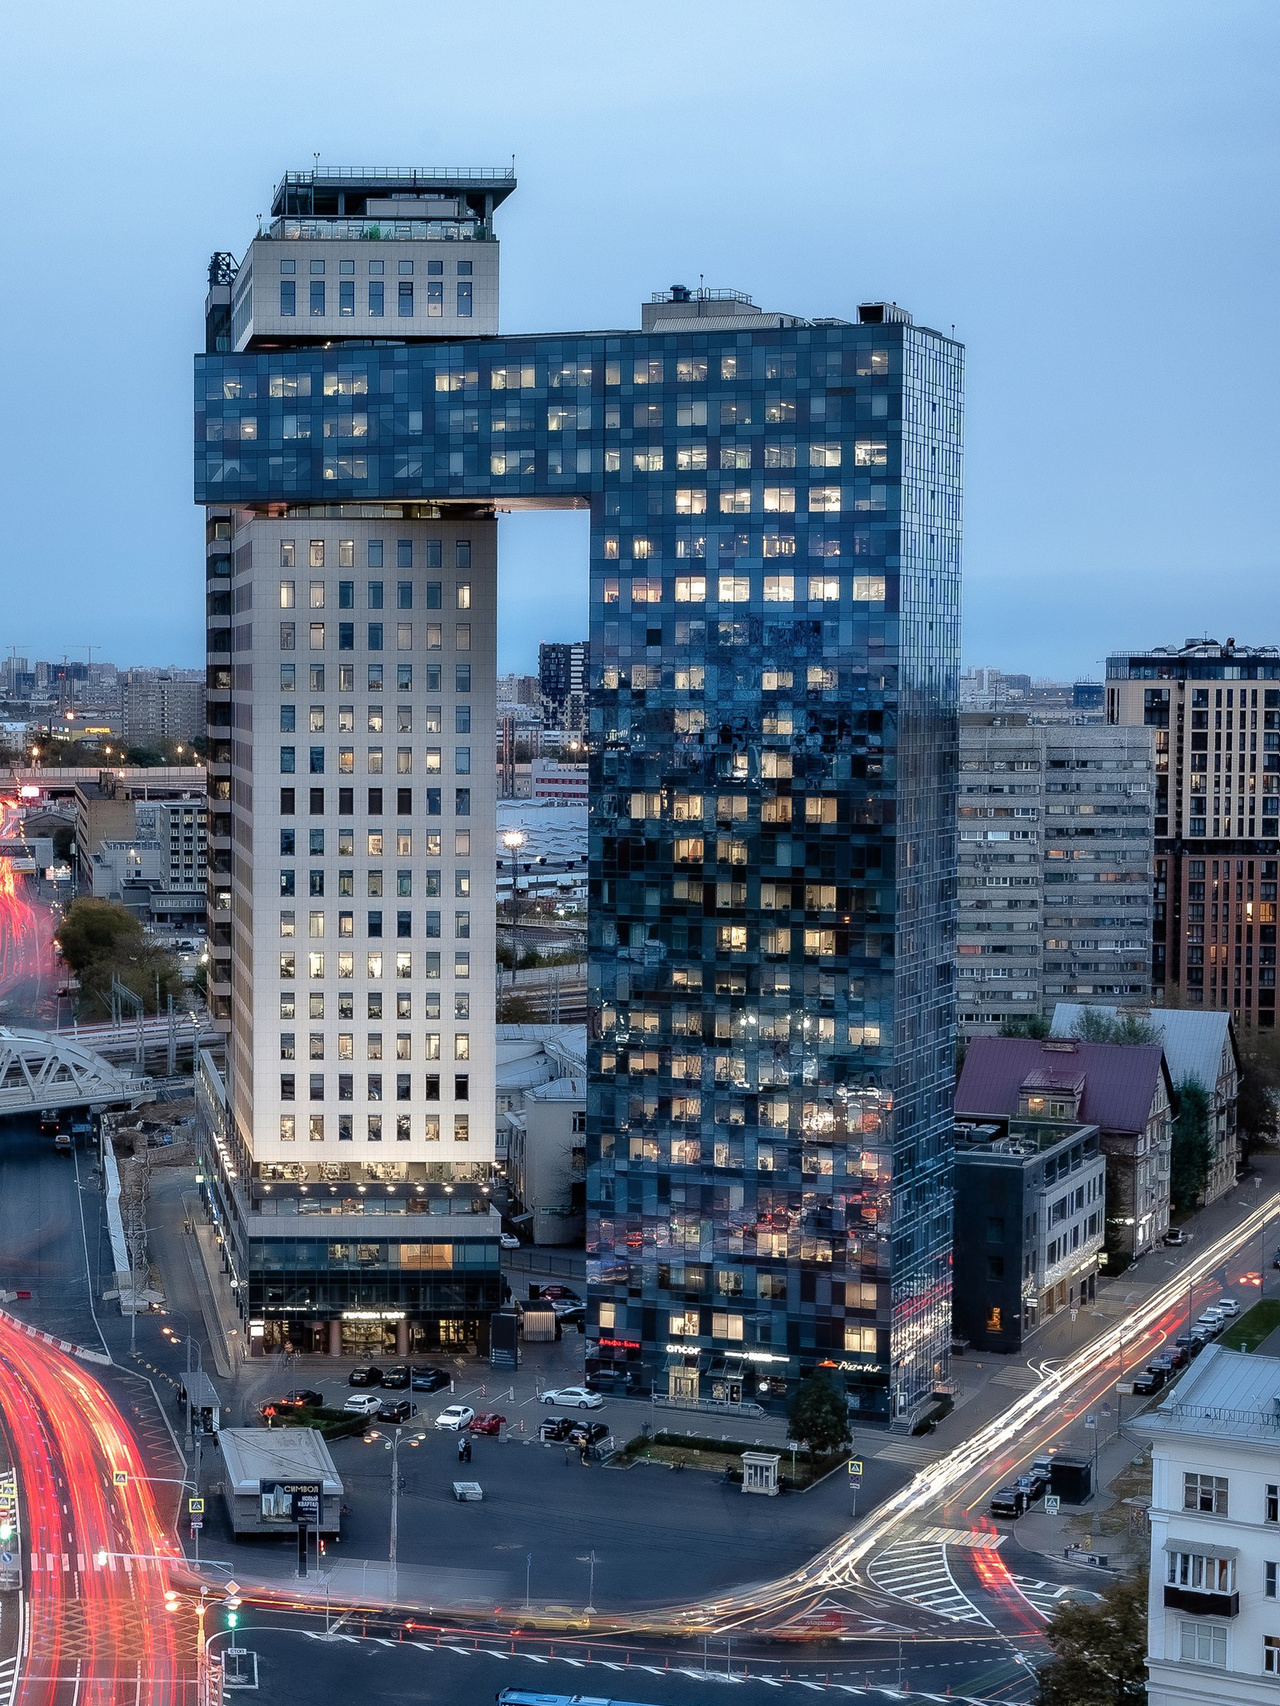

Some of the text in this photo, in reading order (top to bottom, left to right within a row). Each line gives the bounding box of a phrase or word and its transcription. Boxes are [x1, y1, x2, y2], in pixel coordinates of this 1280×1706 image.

[599, 1338, 640, 1349] Альфа-Банк
[838, 1361, 882, 1373] Pizza Hut
[284, 1485, 319, 1493] СИМВОЛ
